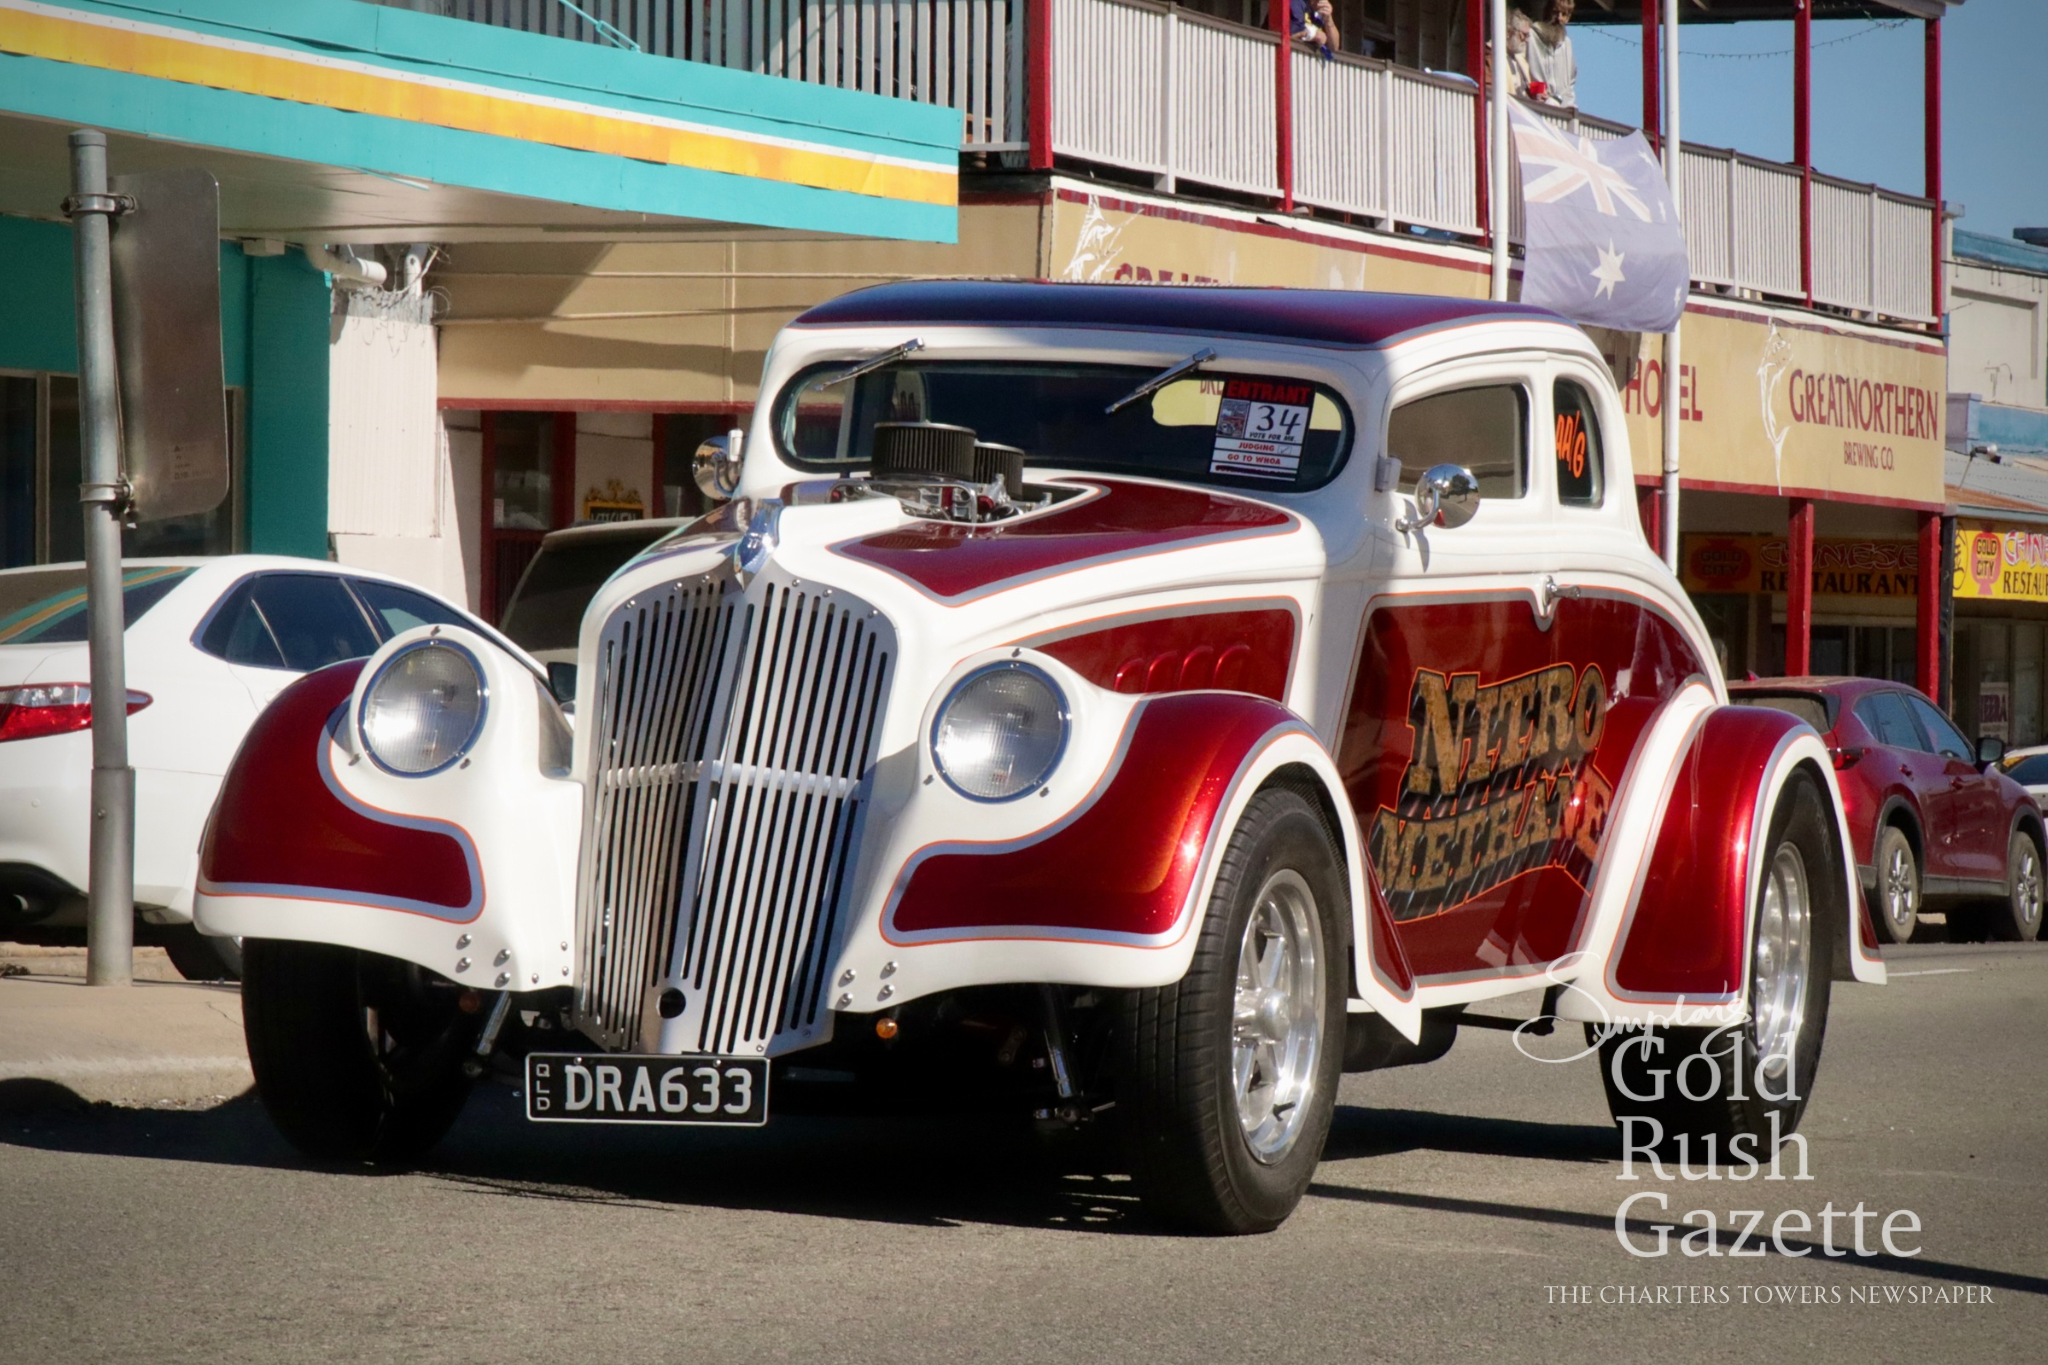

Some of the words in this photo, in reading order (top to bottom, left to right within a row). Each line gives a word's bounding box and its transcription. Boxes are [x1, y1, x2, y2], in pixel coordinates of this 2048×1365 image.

[1226, 380, 1311, 404] ENTRANT
[1625, 357, 1702, 421] HOEL
[1256, 405, 1301, 436] 34
[1238, 442, 1275, 452] JUDGING
[1268, 433, 1282, 441] FOR
[1227, 453, 1240, 461] GO
[1242, 454, 1253, 462] TO
[1255, 456, 1281, 465] WHOA
[1843, 441, 1878, 469] BREWING
[1880, 445, 1895, 471] CO.
[1700, 551, 1742, 562] GOLD
[1976, 538, 1997, 556] GOLD
[1700, 565, 1739, 576] CITY
[1976, 560, 1994, 577] CITY
[1761, 570, 1919, 595] RETAURANT
[1407, 663, 1606, 796] NITRO
[1375, 763, 1611, 893] METHANE
[564, 1064, 753, 1115] DRA633
